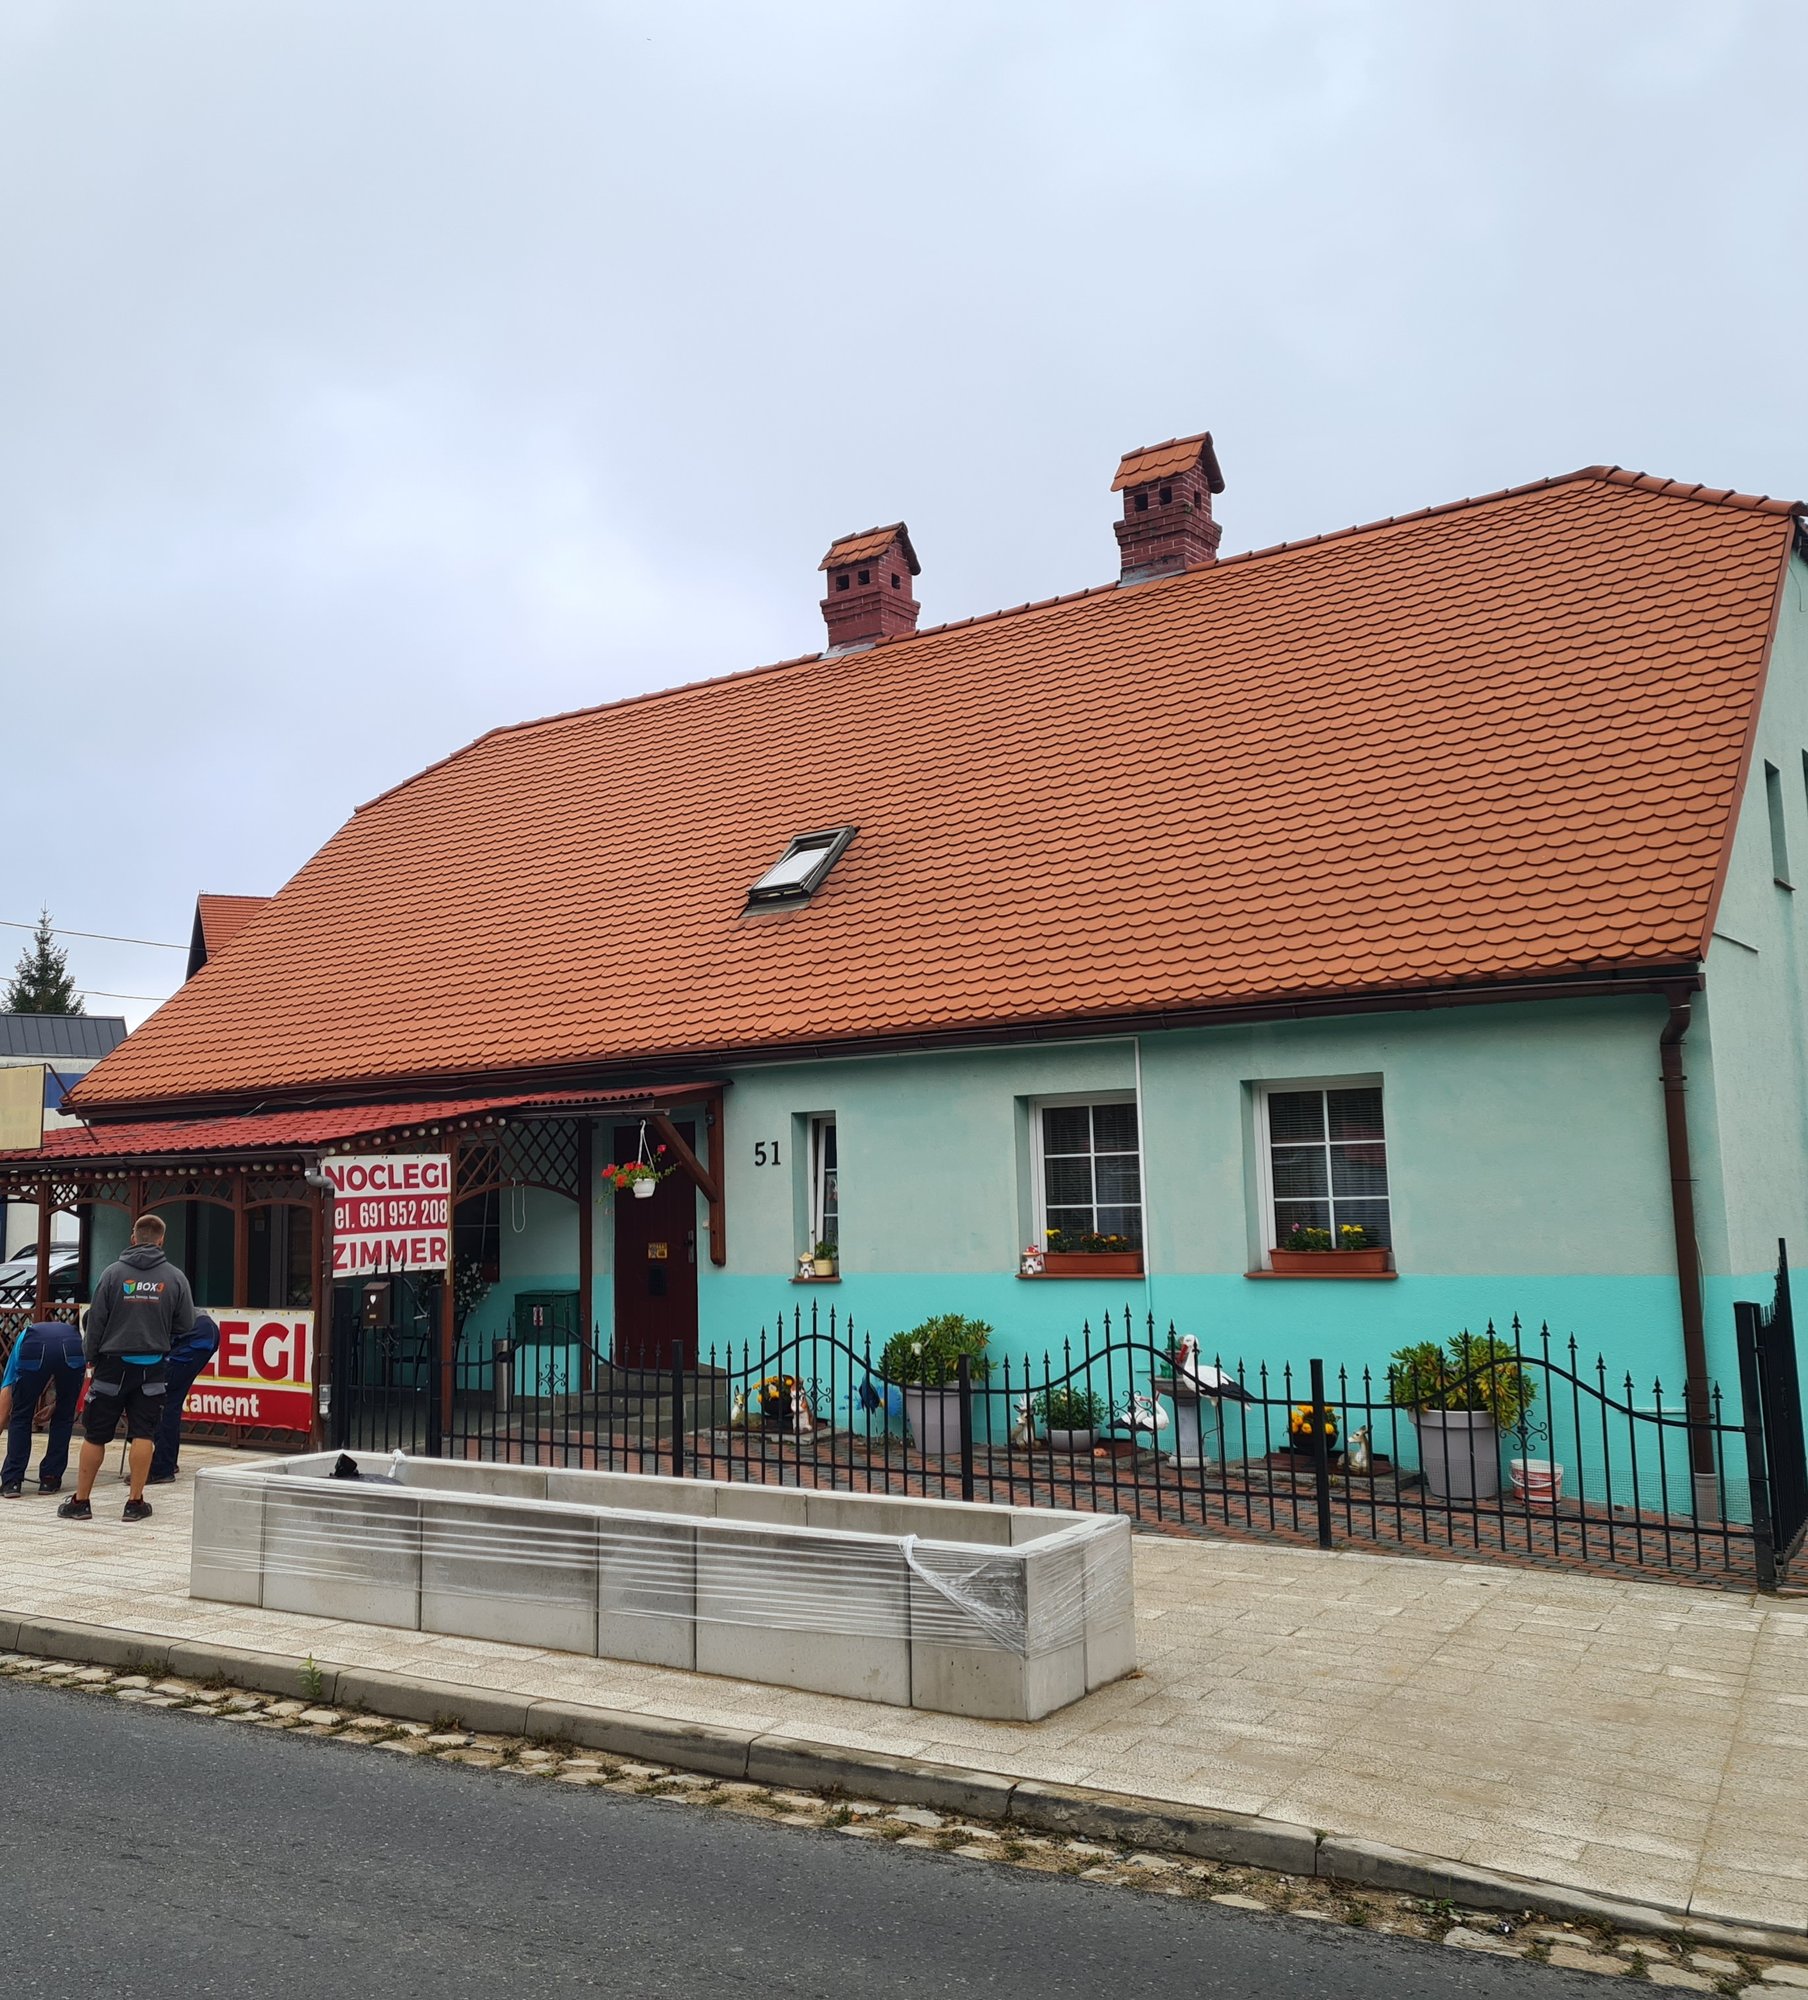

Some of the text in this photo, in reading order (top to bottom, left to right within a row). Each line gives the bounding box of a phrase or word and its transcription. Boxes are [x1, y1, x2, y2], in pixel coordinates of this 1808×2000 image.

[755, 1141, 781, 1167] 51
[325, 1163, 448, 1192] NOCLEGI
[334, 1199, 448, 1229] el. 691 952 208
[333, 1237, 447, 1271] ZIMMER
[201, 1321, 307, 1383] EGI
